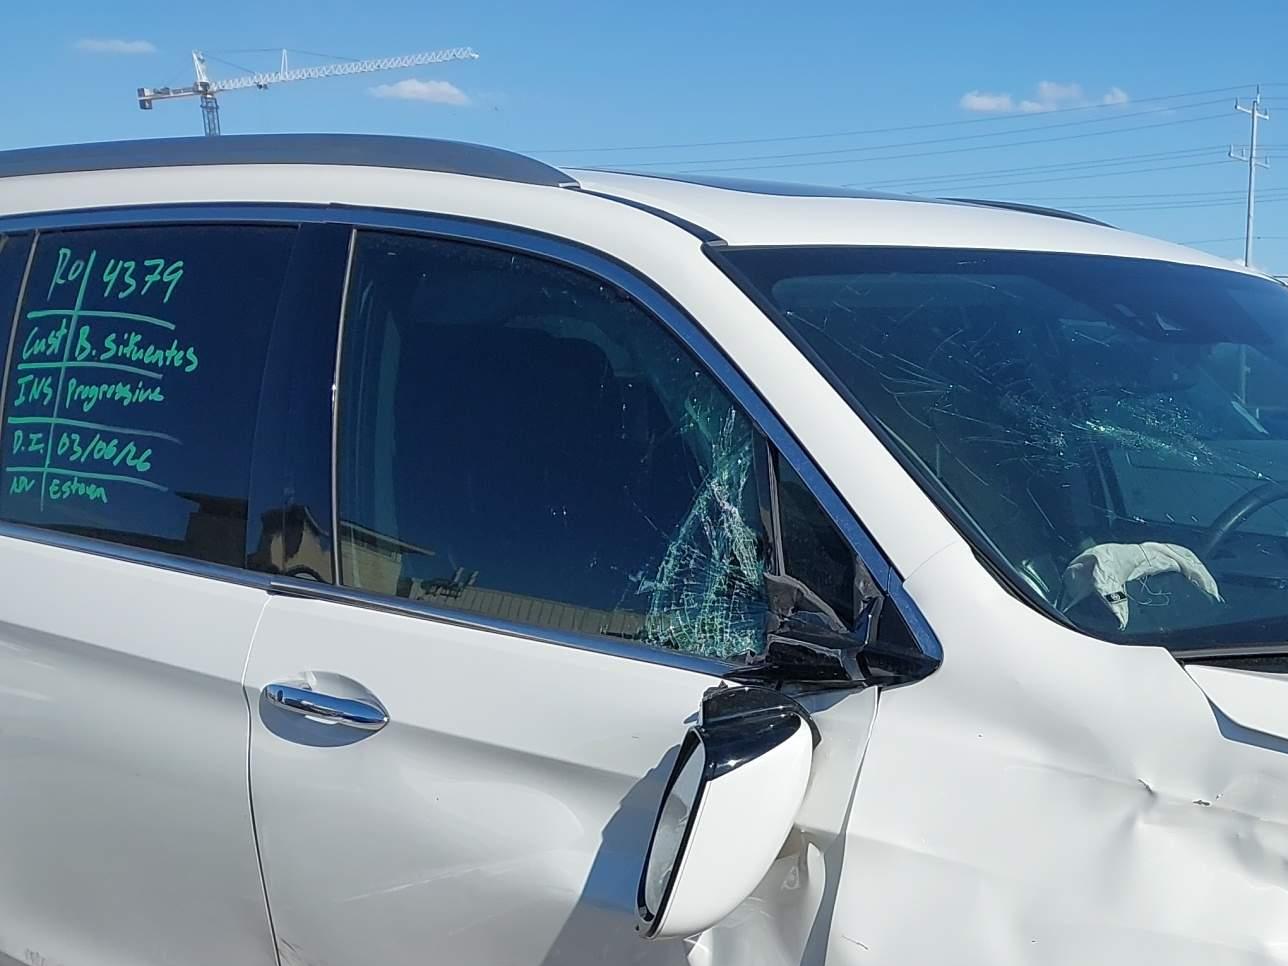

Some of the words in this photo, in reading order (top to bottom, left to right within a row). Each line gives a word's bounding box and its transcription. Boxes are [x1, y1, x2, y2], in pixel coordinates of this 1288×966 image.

[103, 258, 185, 304] 4379
[14, 374, 54, 406] INS
[66, 378, 165, 413] Progressive
[57, 432, 153, 472] 03/06/26
